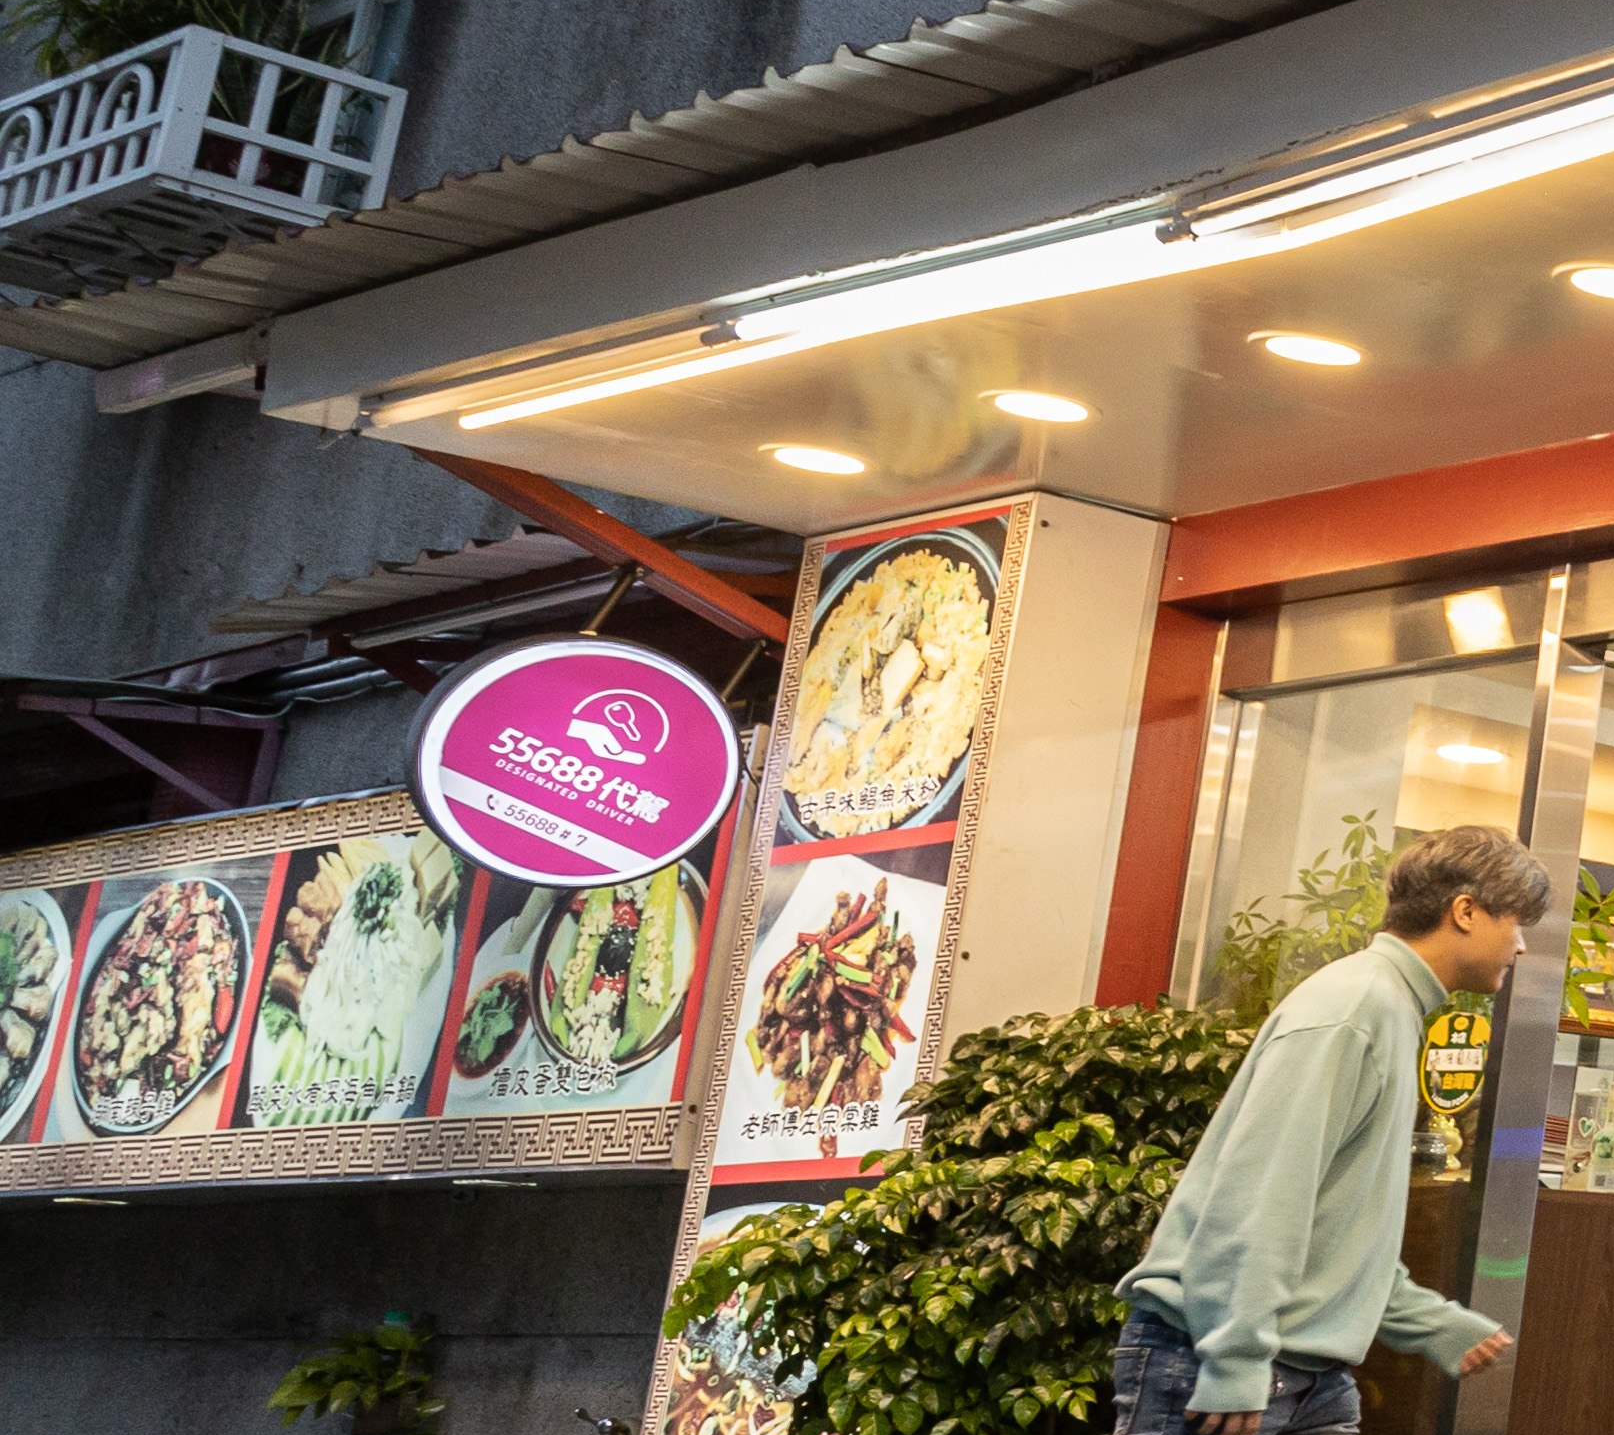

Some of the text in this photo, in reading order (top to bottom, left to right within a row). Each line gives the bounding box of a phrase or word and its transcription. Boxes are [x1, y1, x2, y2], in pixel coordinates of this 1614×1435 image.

[495, 758, 635, 827] DESIGNATED DRIVER
[503, 803, 557, 836] 55688
